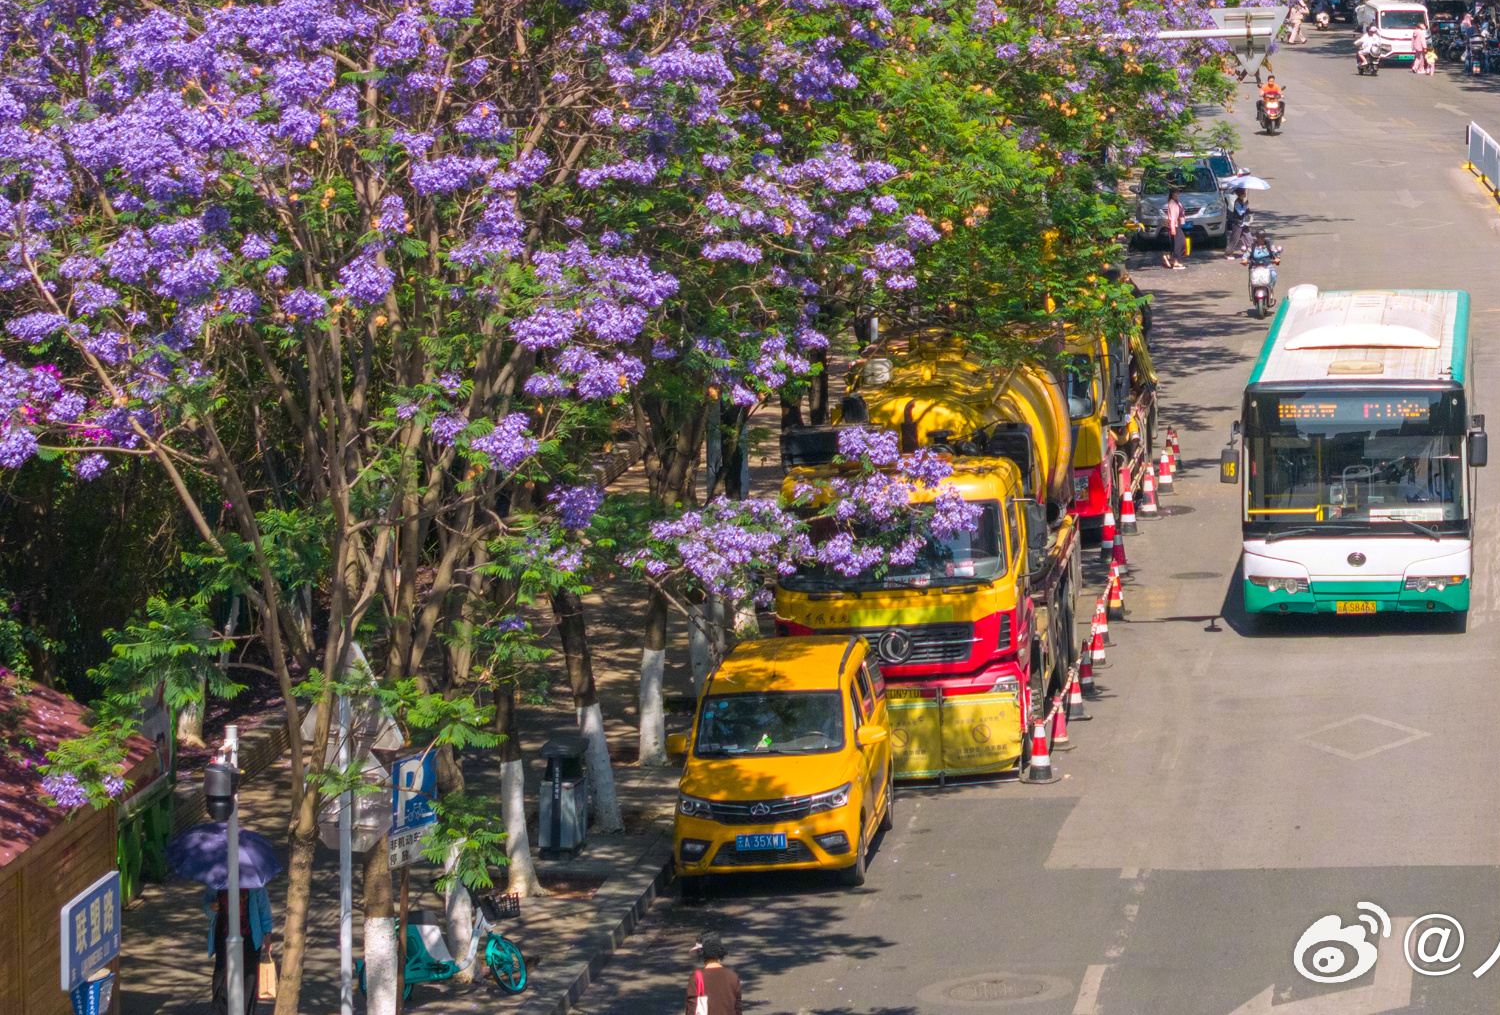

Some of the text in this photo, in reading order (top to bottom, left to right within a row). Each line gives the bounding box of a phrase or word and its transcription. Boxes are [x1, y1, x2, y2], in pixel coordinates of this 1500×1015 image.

[397, 759, 424, 827] P
[390, 831, 421, 851] 非机动车
[75, 888, 114, 956] 联盟路
